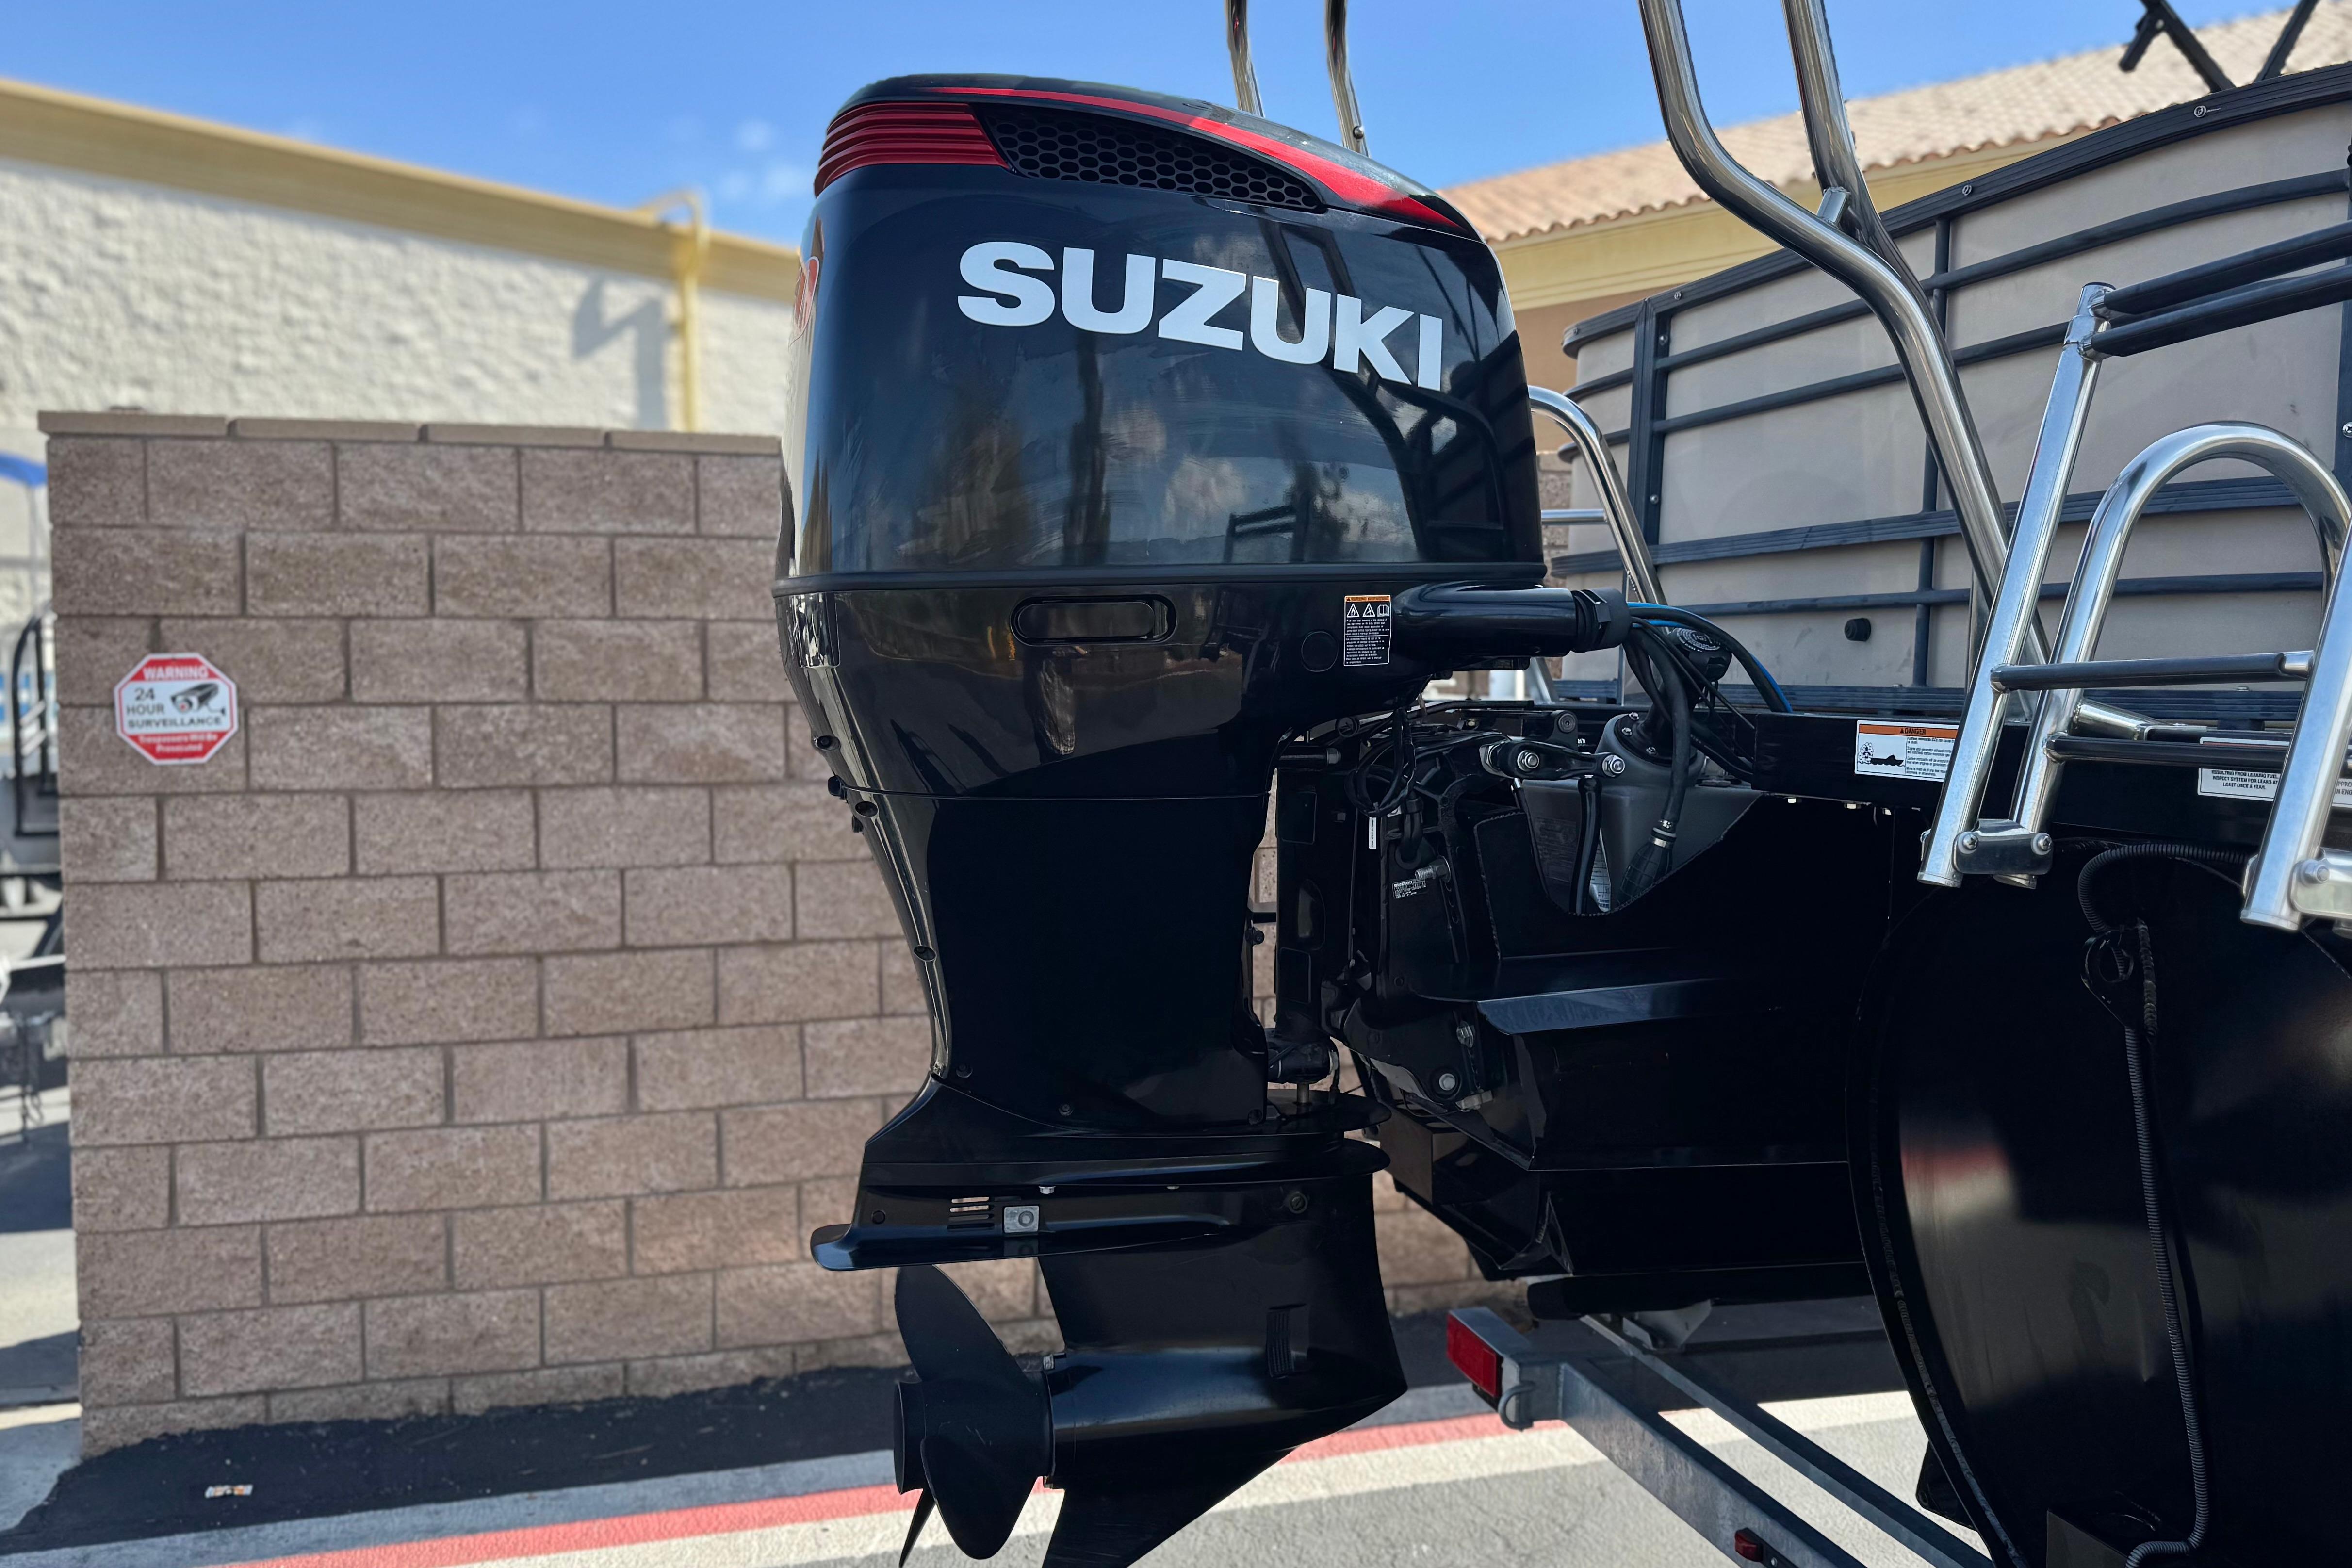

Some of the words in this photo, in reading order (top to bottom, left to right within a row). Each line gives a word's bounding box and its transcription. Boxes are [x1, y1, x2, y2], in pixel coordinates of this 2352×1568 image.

[957, 241, 1442, 391] SUZUKI
[143, 666, 209, 681] WARNING
[135, 687, 155, 701] 24
[126, 703, 164, 715] HOUR
[128, 717, 222, 728] SURVEILLANCE
